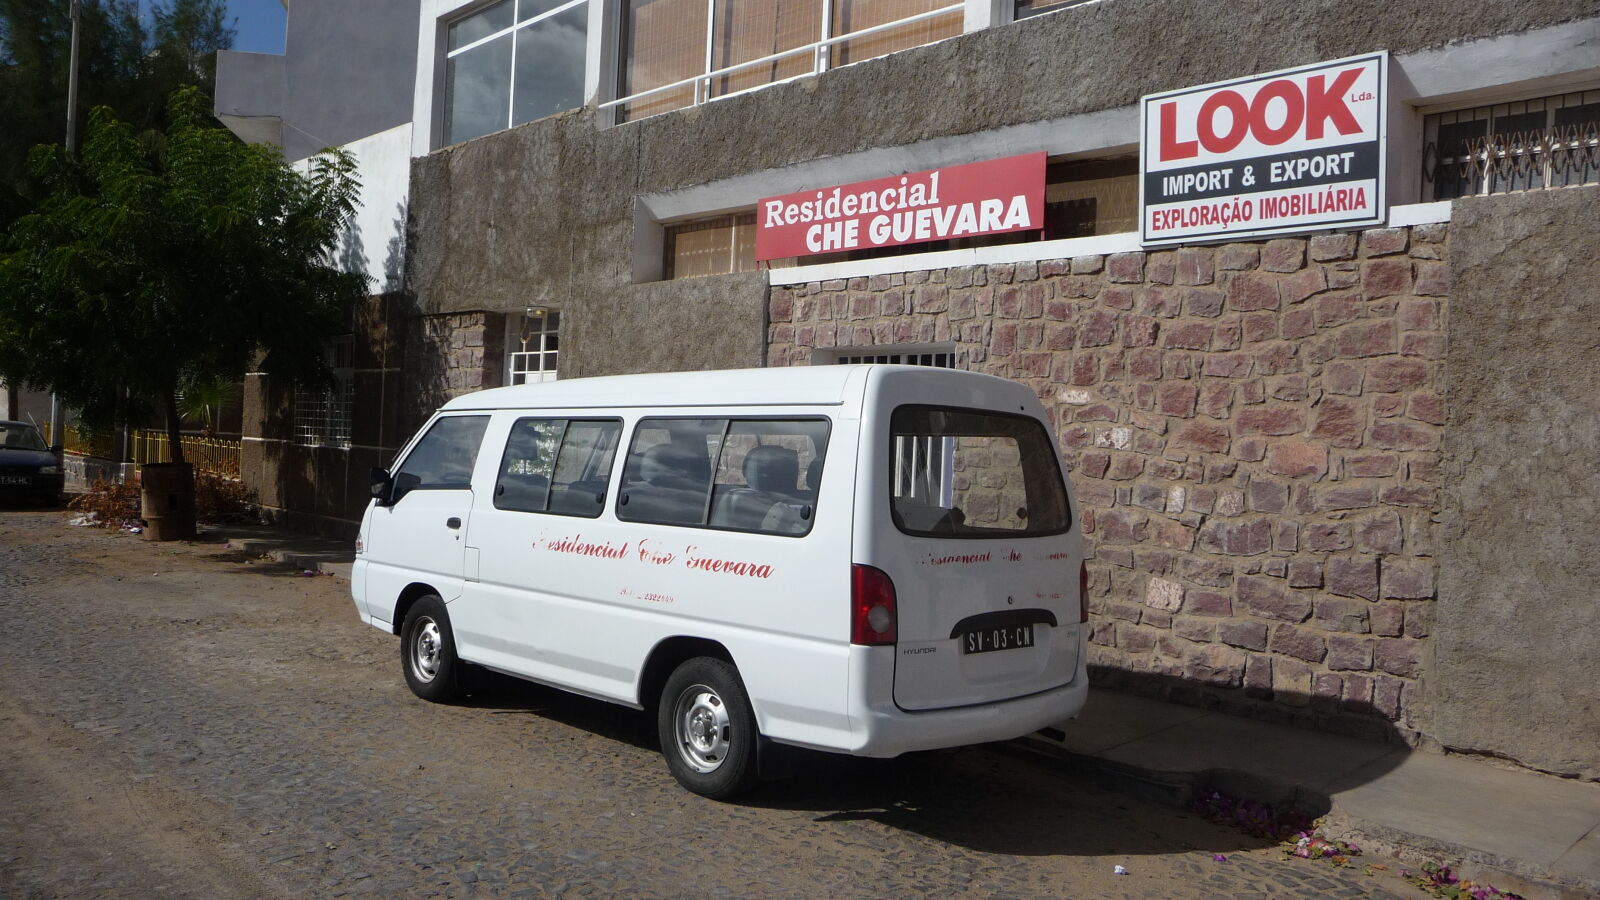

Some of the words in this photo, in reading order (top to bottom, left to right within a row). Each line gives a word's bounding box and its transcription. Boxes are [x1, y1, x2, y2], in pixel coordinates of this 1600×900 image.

[1160, 67, 1366, 162] LOOK
[1351, 91, 1376, 103] Lda.
[1162, 168, 1234, 197] IMPORT
[1241, 165, 1256, 187] &
[1269, 152, 1355, 183] EXPORT
[764, 171, 940, 229] Residencial
[1152, 197, 1253, 230] EXPLORAÇÃO
[1259, 185, 1367, 219] IMOBILIÁRIA
[806, 219, 859, 252] CHE
[868, 195, 1031, 245] GUEVARA
[903, 647, 937, 656] HYUNDAI
